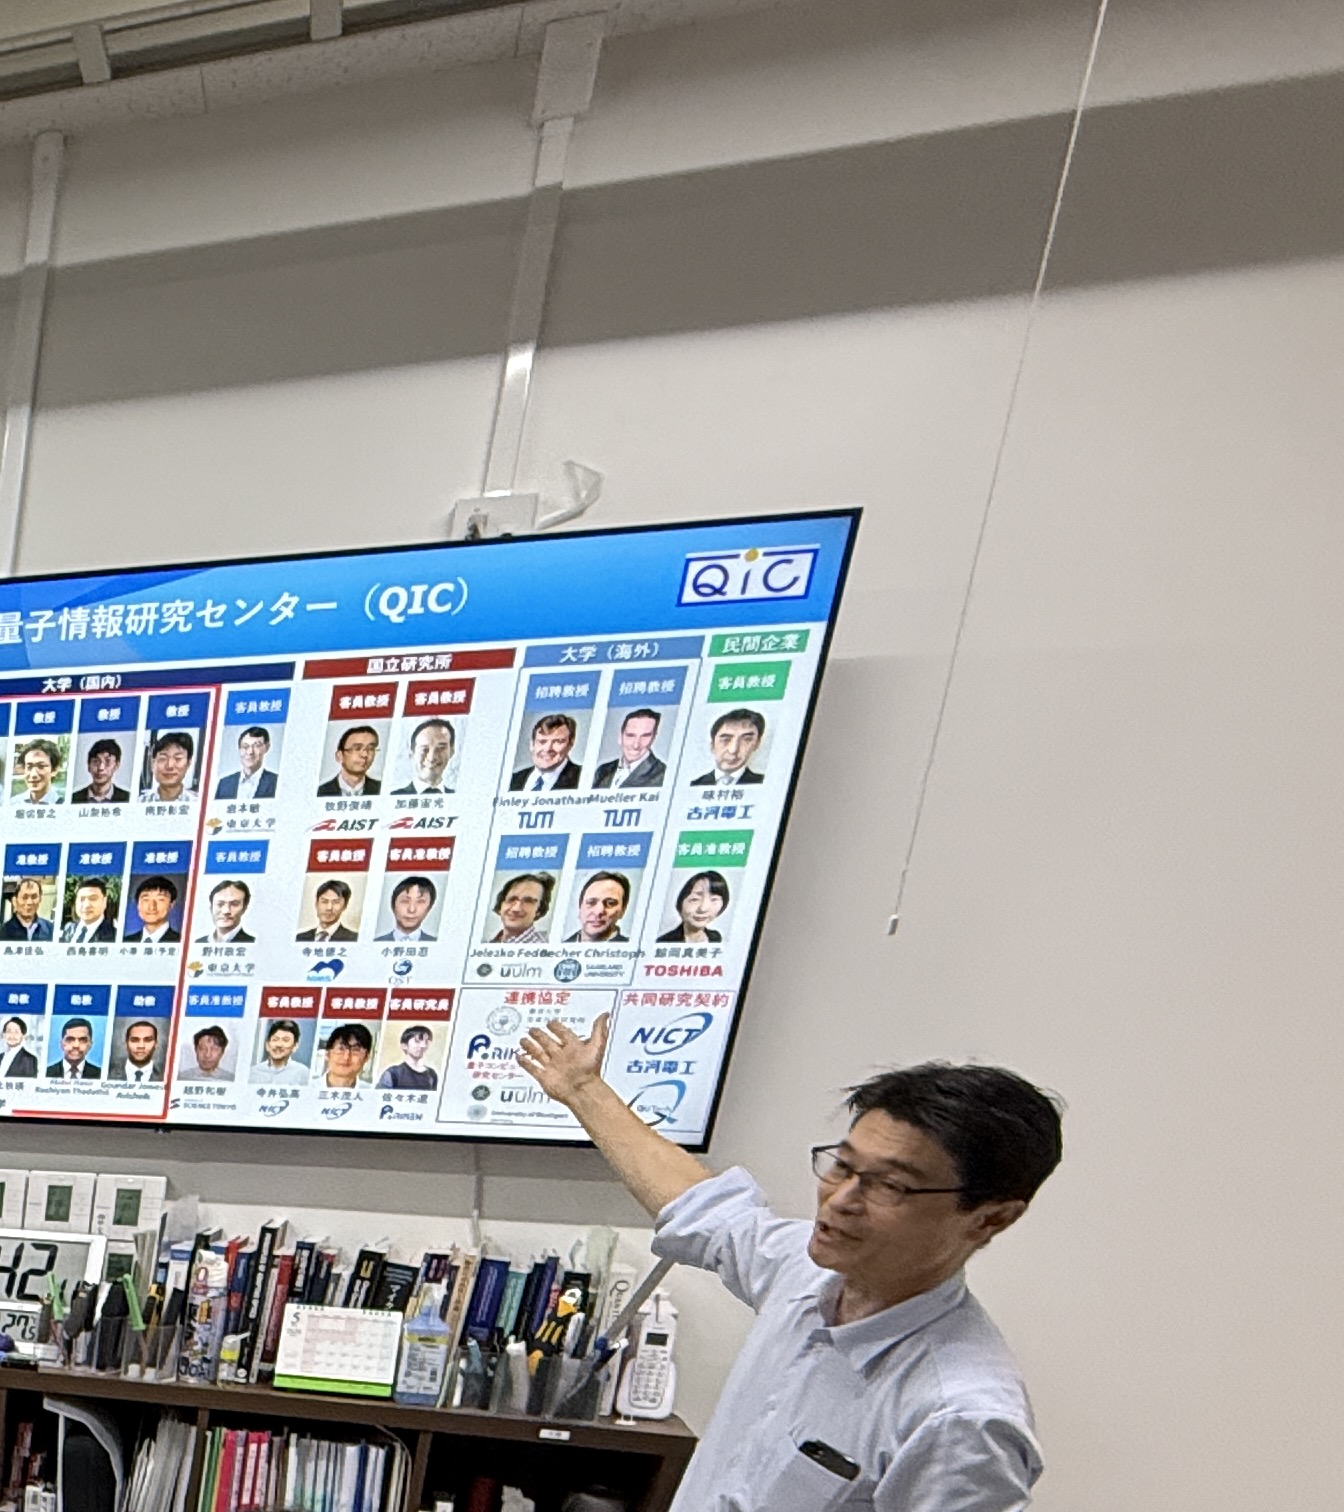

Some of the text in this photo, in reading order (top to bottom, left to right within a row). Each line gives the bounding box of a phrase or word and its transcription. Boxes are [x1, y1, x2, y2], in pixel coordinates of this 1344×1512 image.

[721, 634, 801, 654] 民間企業
[366, 653, 452, 674] 国立研究所
[718, 674, 775, 691] 客員教授
[338, 693, 390, 710] 客員教授
[414, 689, 467, 706] 客員教授
[165, 704, 190, 718] 教授
[234, 699, 283, 714] 客員教授
[32, 711, 56, 725] 教授
[97, 707, 121, 721] 教授
[639, 791, 660, 803] Kai
[336, 818, 379, 832] AIST
[413, 816, 459, 830] AIST
[15, 853, 49, 866] 准教授
[78, 852, 113, 865] 准教授
[143, 851, 179, 864] 准教授
[215, 850, 261, 863] 客員教授
[316, 849, 366, 863] 客員教授
[643, 964, 723, 978] TOSHIBA
[188, 994, 243, 1007] 客員准教授
[267, 996, 314, 1009] 客員教授
[330, 997, 378, 1010] 客員教授
[389, 998, 450, 1012] 客員研究員
[503, 990, 571, 1006] 連携協定
[622, 992, 731, 1008] 共同研究契約
[630, 1026, 704, 1045] NICT
[491, 1047, 524, 1060] RIK
